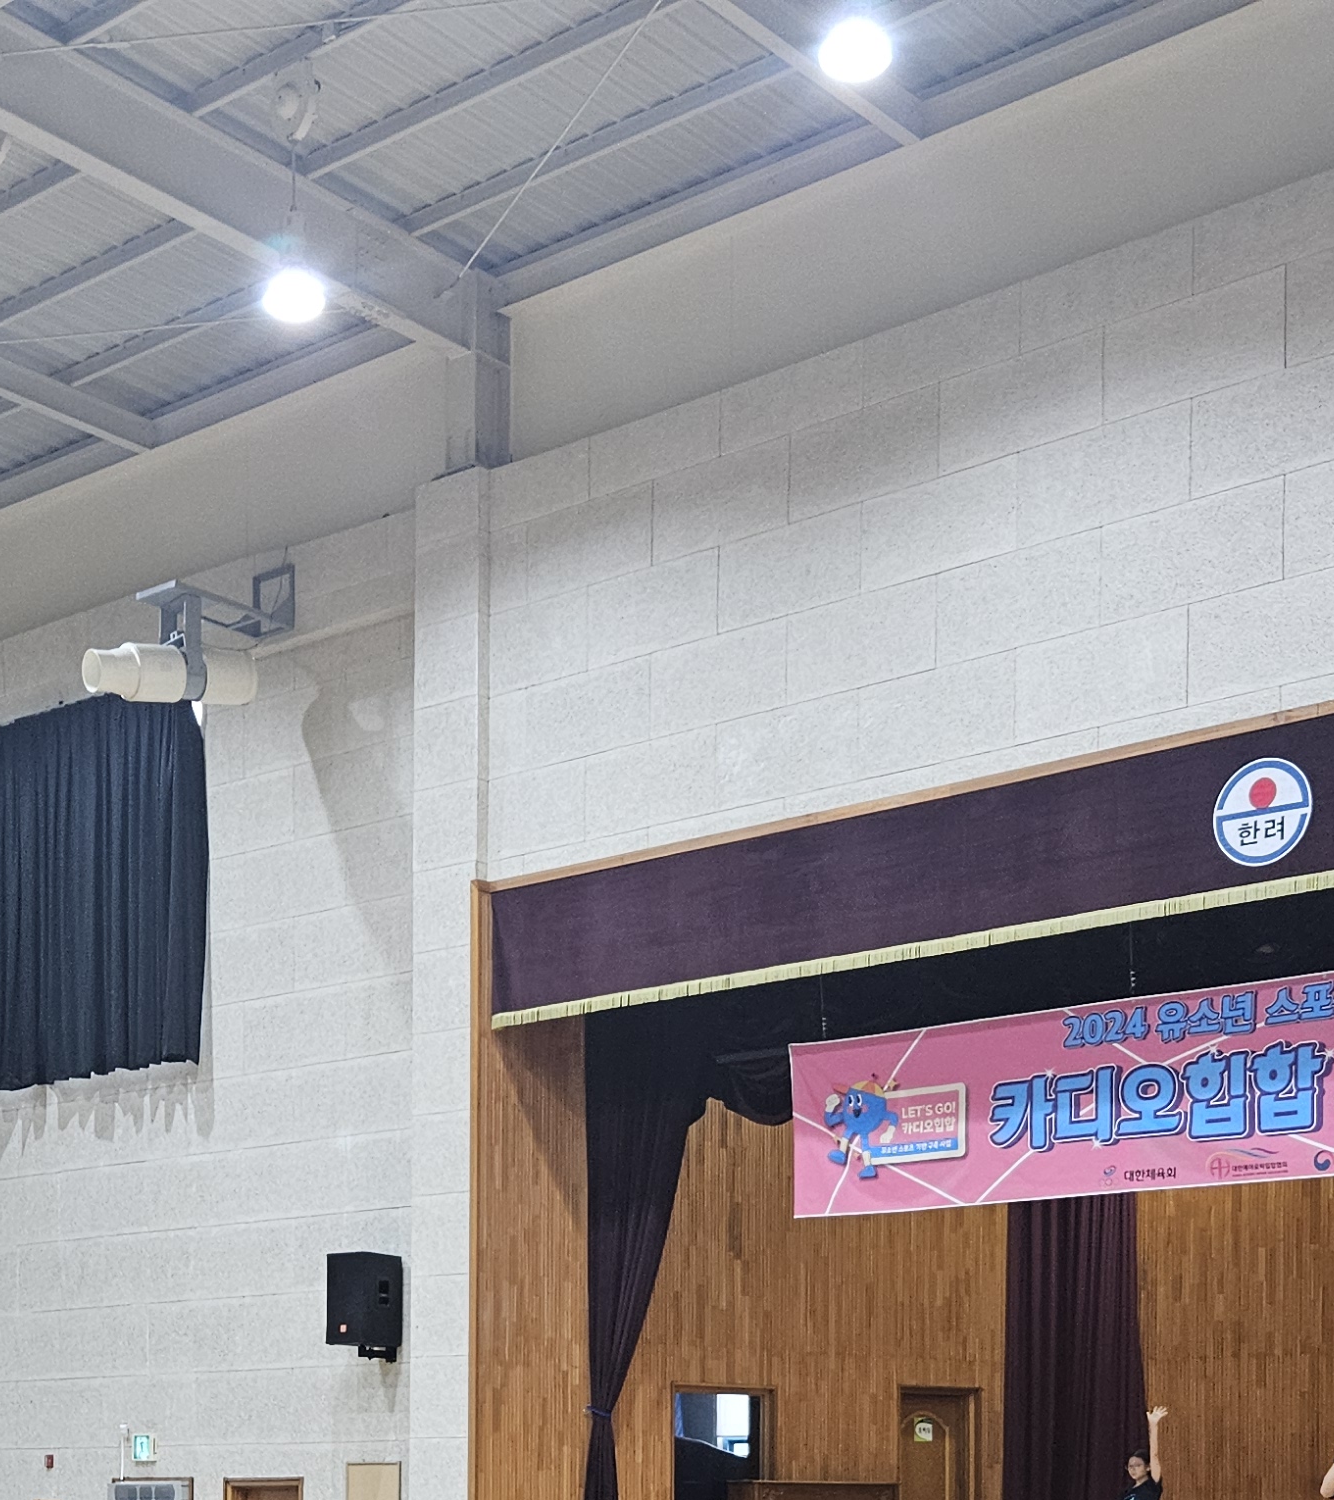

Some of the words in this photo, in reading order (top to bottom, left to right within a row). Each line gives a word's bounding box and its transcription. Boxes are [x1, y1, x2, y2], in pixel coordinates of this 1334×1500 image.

[1237, 816, 1285, 846] 한려
[1062, 1006, 1150, 1049] 2024
[1155, 990, 1257, 1044] 유소년
[901, 1104, 933, 1119] LET'S
[934, 1101, 956, 1115] GO!
[988, 1040, 1334, 1153] 카디오힙합
[1124, 1167, 1177, 1182] 대한체육회
